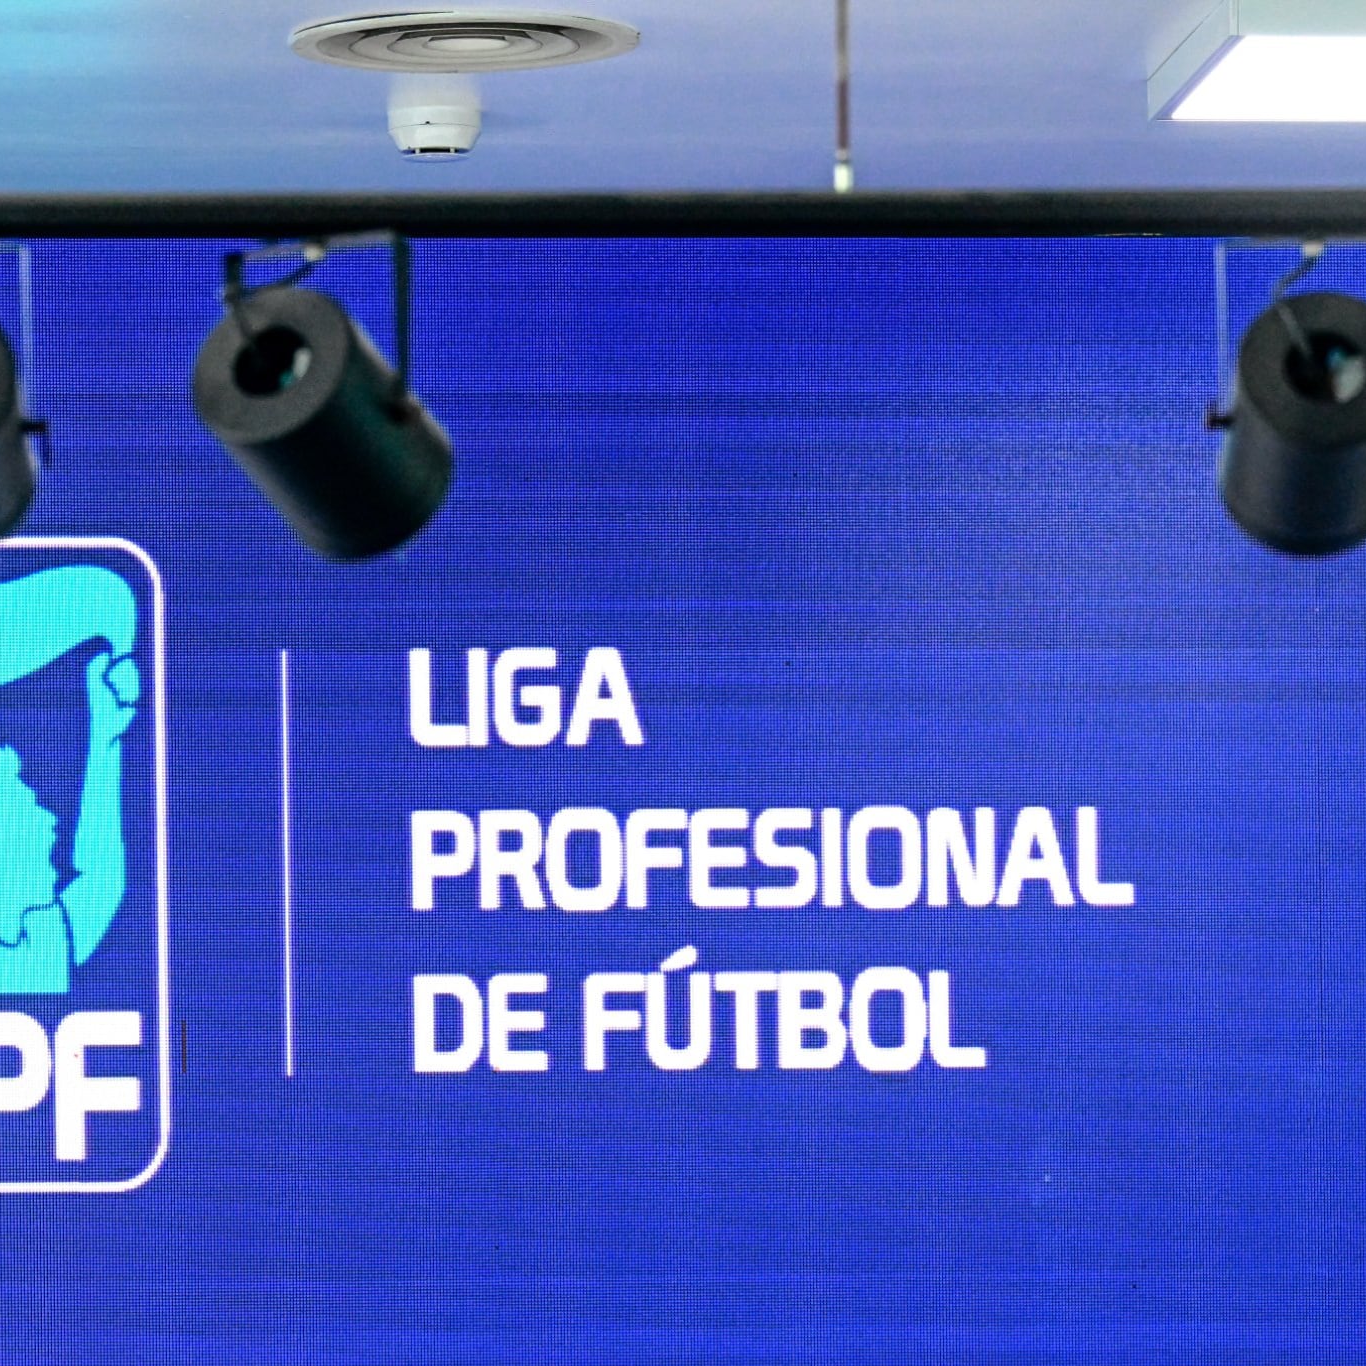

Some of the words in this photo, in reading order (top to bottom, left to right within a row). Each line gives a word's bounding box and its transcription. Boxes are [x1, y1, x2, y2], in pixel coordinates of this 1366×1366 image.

[408, 646, 644, 747] LIGA
[410, 805, 1135, 912] PROFESIONAL
[412, 973, 549, 1073] DE
[583, 945, 987, 1072] FÚTBOL
